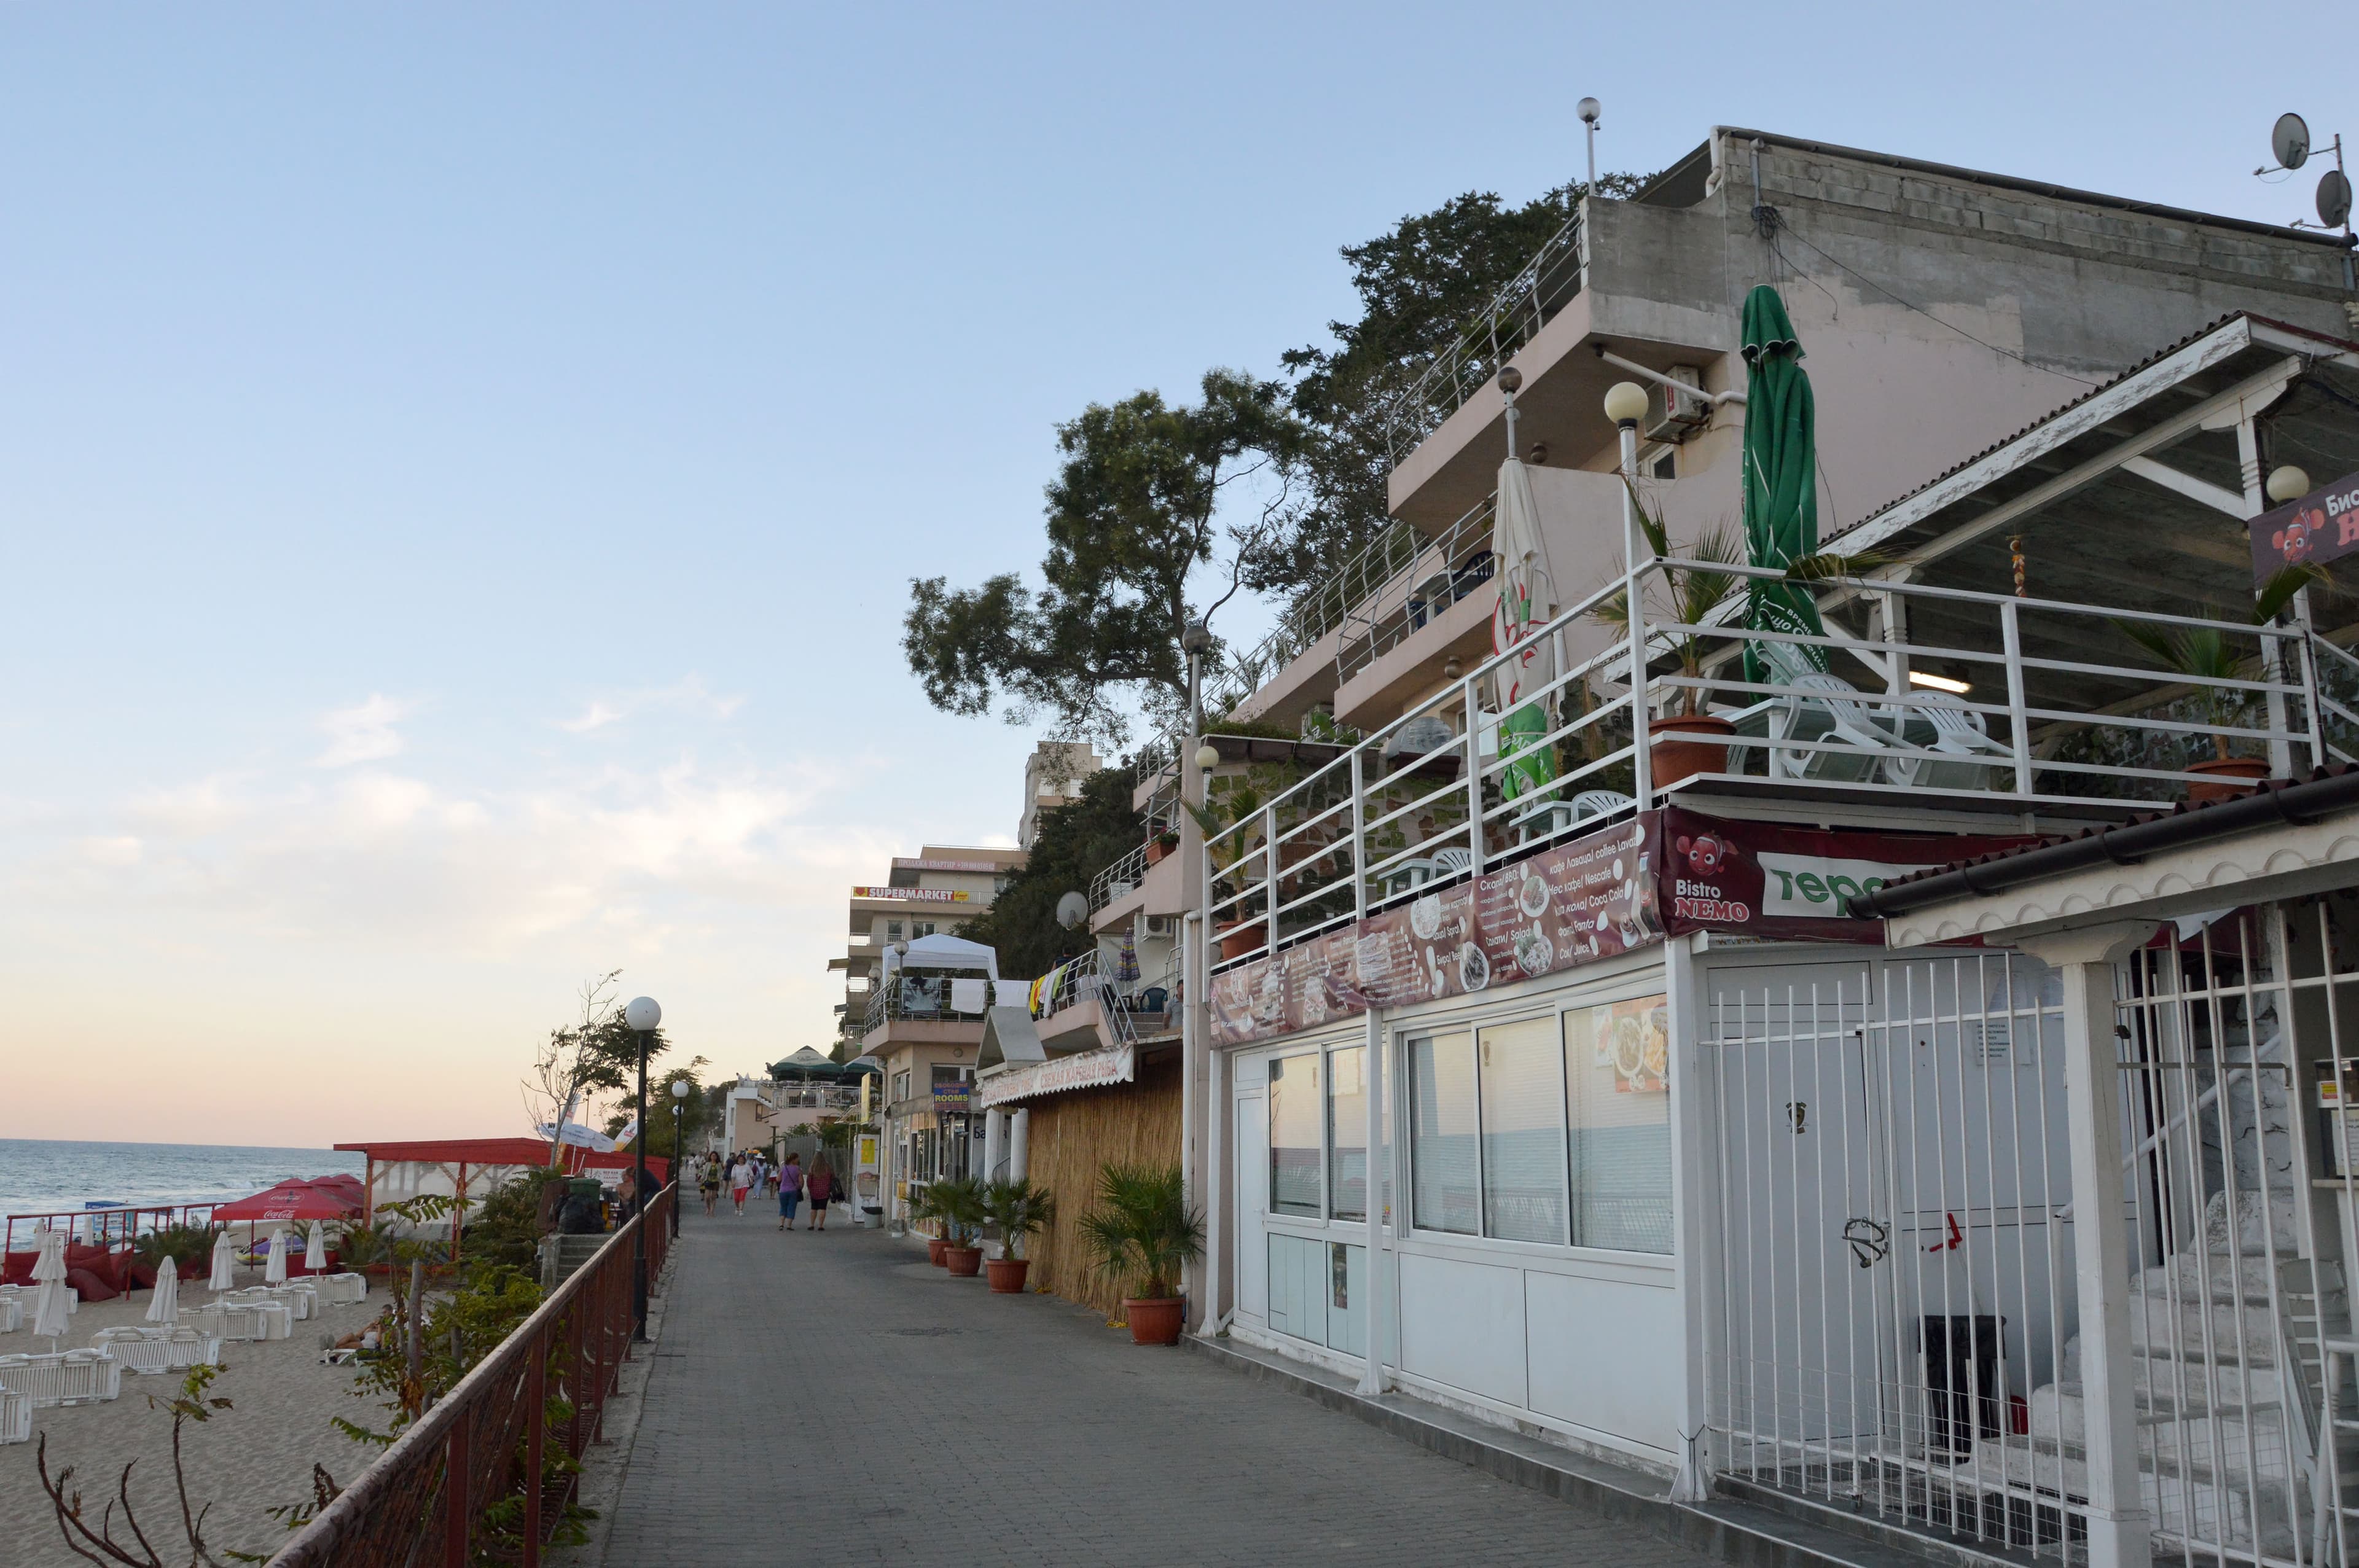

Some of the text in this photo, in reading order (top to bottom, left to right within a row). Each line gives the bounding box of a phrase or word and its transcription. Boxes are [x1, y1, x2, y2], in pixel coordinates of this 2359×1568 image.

[1596, 843, 1616, 860] coffee
[1585, 866, 1611, 886] Nescafe
[869, 887, 953, 900] SUPERMARKET
[1675, 878, 1721, 899] Bistro
[1589, 893, 1608, 908] Coca
[1608, 887, 1624, 902] Cola
[1675, 897, 1750, 922] NEMO
[1574, 919, 1595, 933] Fanta
[1451, 950, 1461, 961] Bee
[1574, 942, 1590, 956] Juice
